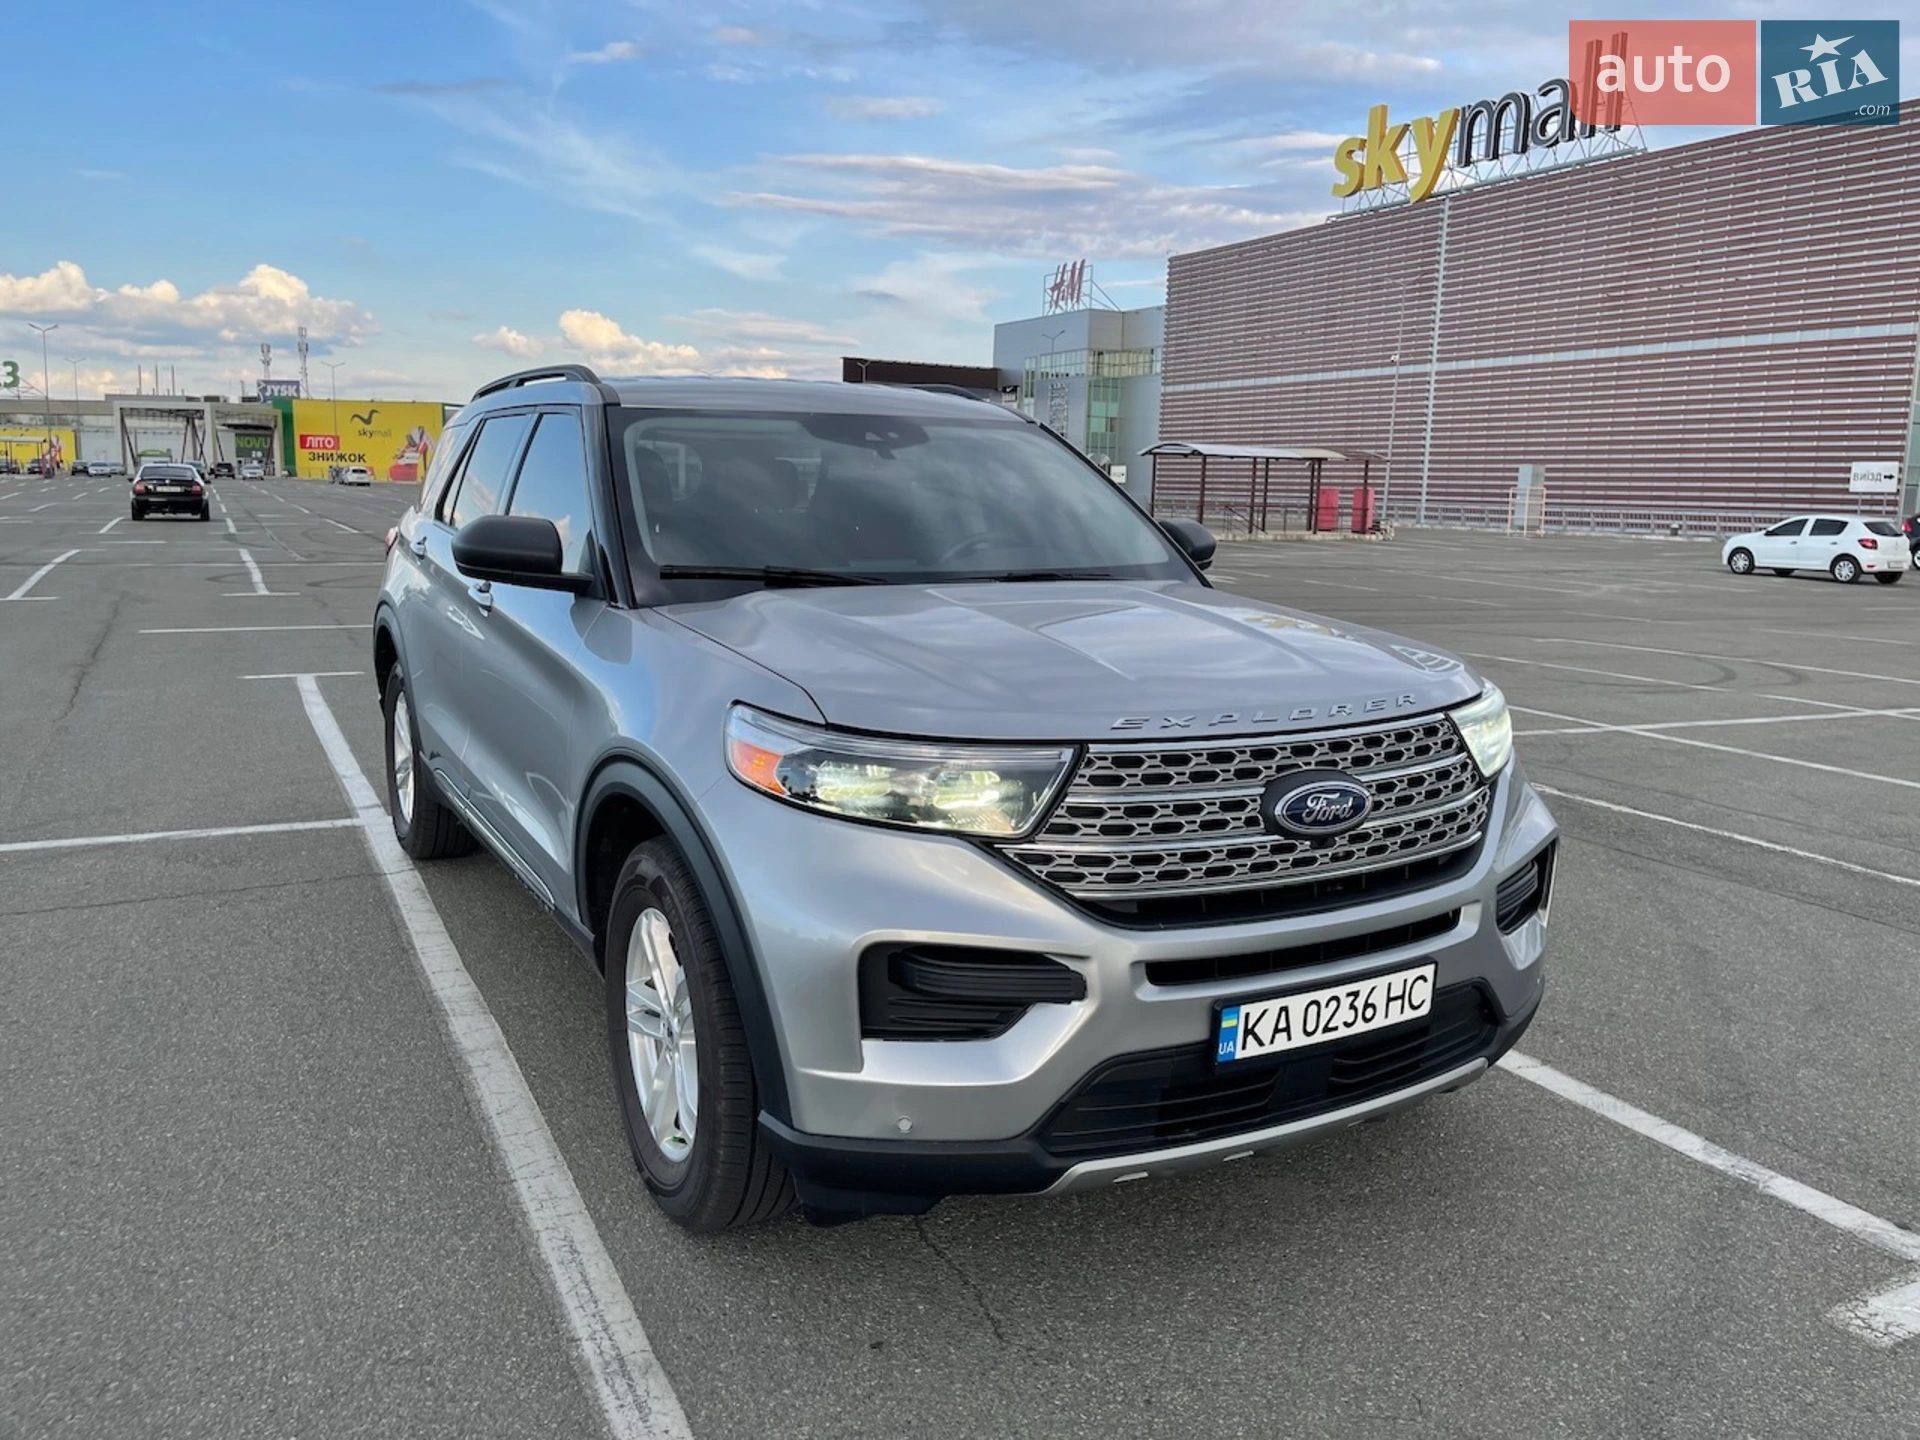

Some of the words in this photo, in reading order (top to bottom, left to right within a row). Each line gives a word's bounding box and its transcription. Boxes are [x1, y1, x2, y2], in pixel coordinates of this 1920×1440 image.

[1332, 31, 1629, 203] skymall
[1049, 259, 1086, 308] H&M
[265, 384, 298, 397] JYSK
[357, 427, 392, 439] skymall
[235, 436, 271, 449] NOVU
[305, 435, 336, 449] ЛІТО
[308, 451, 367, 463] ЗНИЖОК
[1110, 692, 1417, 731] EXPLORER
[1302, 791, 1354, 824] Ford
[1241, 1004, 1293, 1051] KA
[1302, 988, 1377, 1038] 0236
[1383, 974, 1433, 1020] HC
[1219, 1040, 1235, 1055] UA
